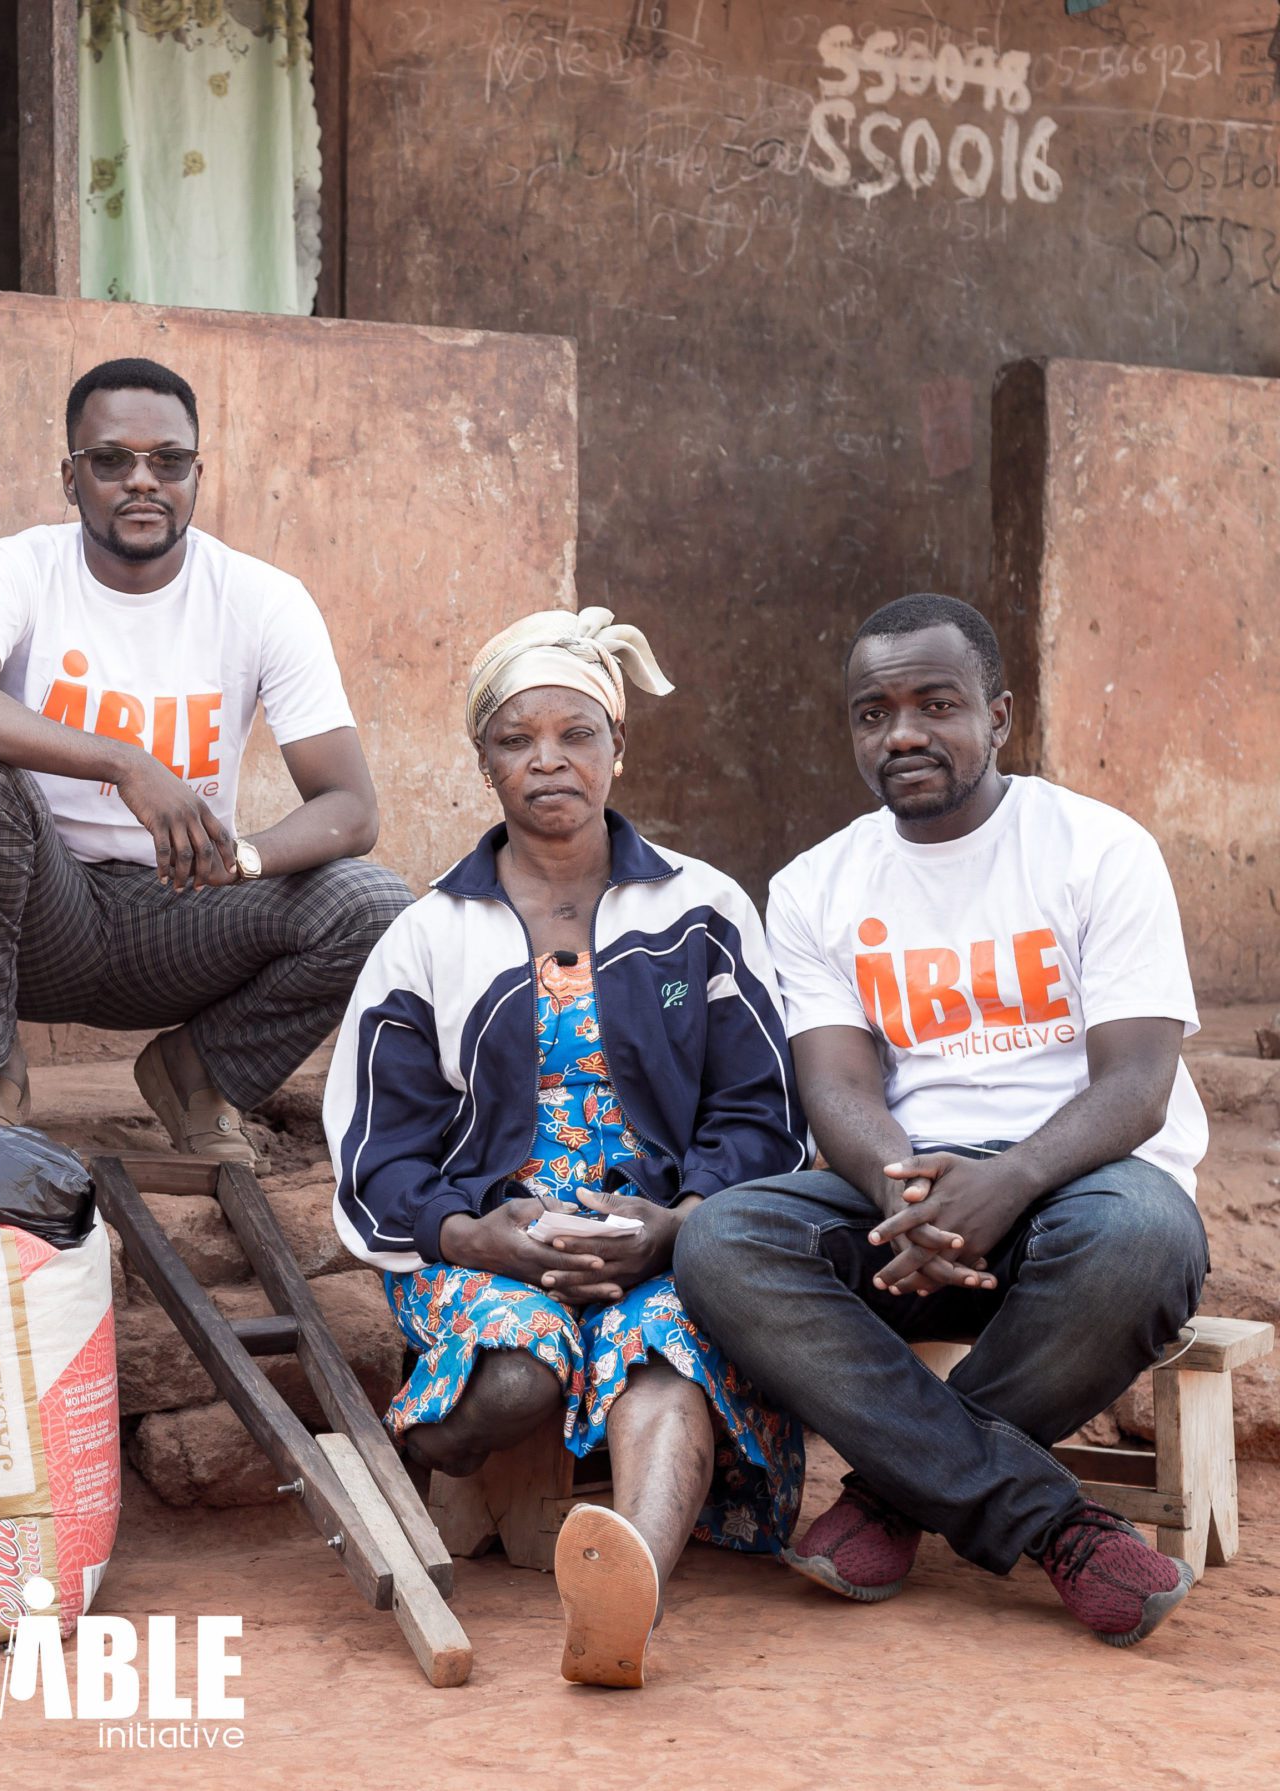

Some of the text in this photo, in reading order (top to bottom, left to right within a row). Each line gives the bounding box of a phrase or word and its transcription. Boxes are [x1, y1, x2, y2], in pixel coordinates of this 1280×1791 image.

[808, 98, 1064, 206] SS0016
[939, 1024, 1076, 1059] initiative
[19, 1522, 42, 1583] elect
